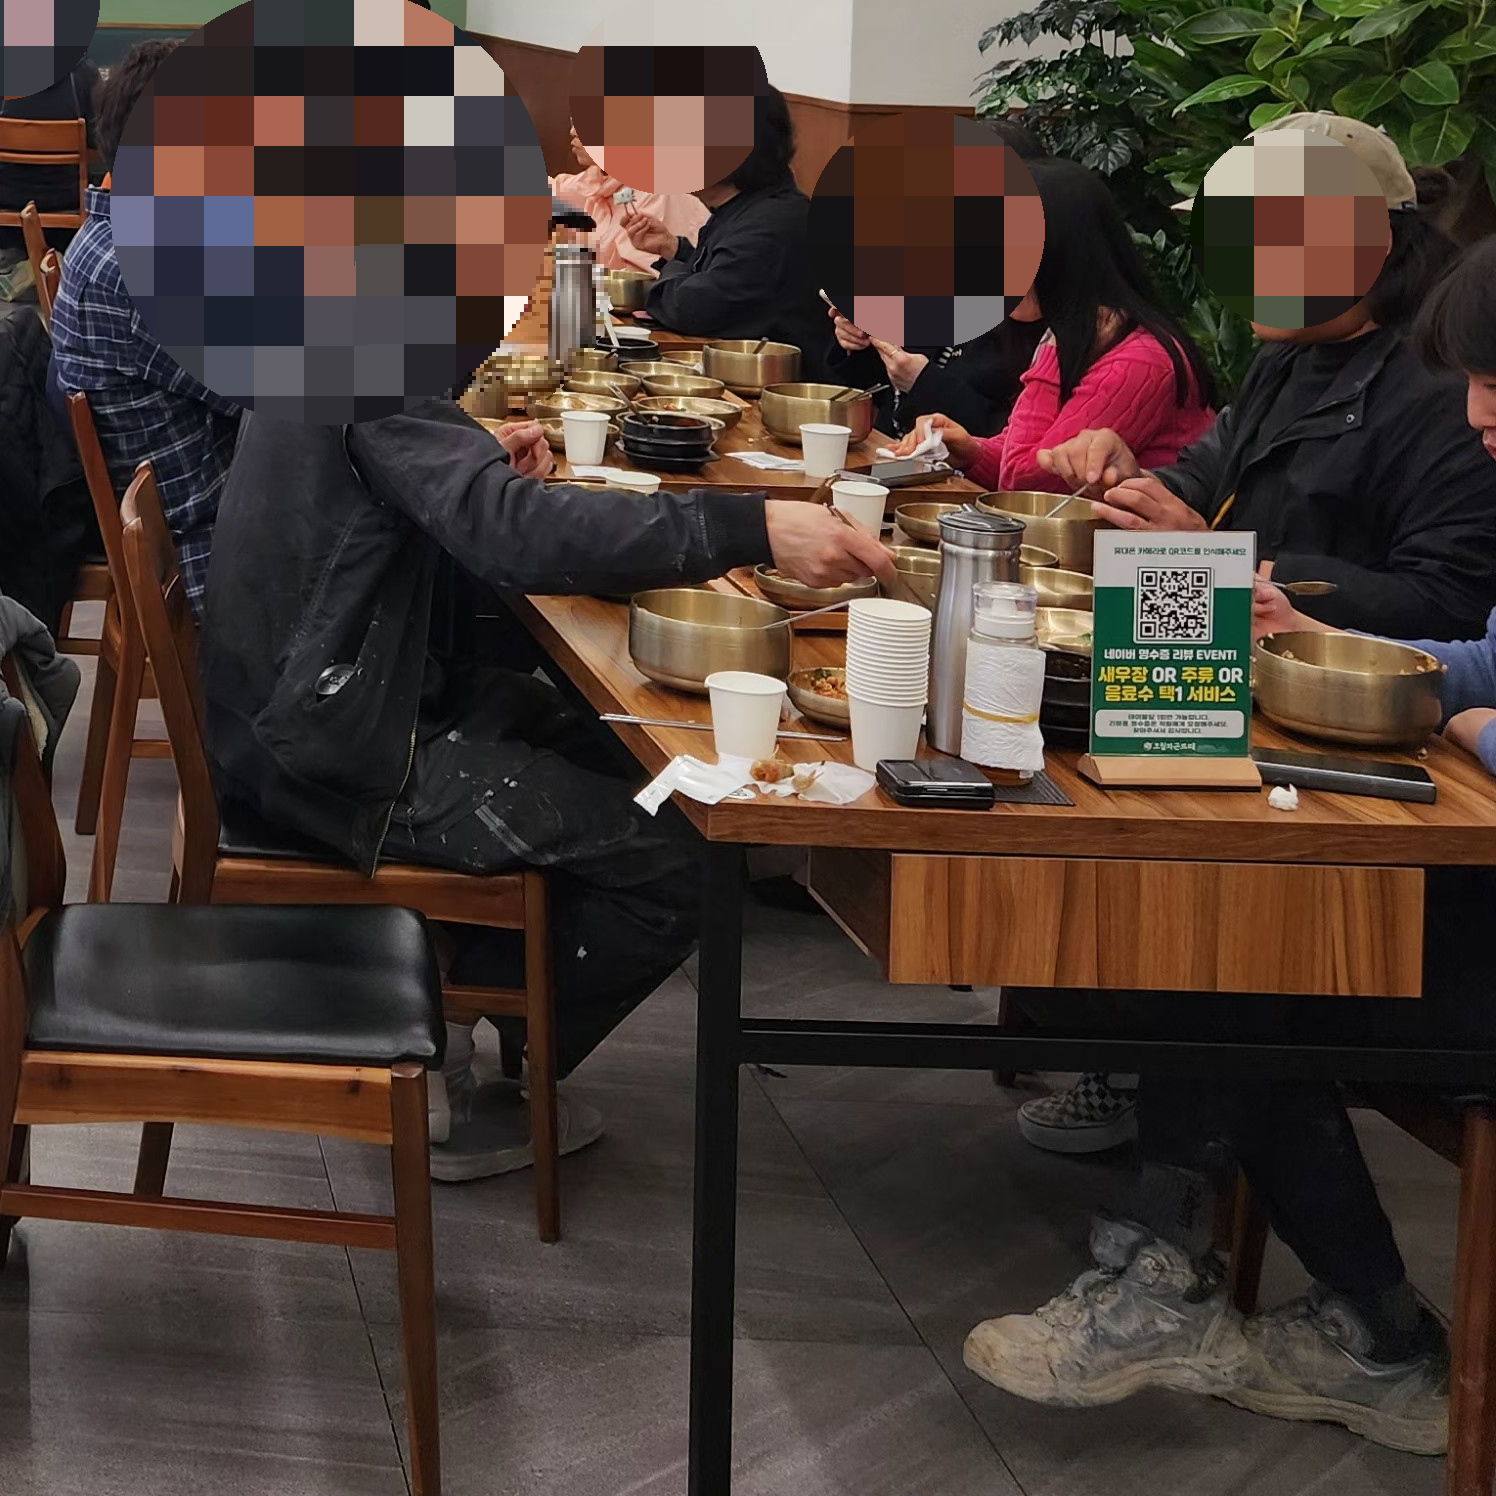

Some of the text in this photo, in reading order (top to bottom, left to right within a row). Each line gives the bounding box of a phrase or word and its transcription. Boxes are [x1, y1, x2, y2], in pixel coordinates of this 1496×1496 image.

[1114, 547, 1246, 556] 휴대폰 카메라로 QR코드를 인식해주세요
[1104, 648, 1237, 661] 네이버 영수증 리뷰 EVENT!
[1098, 666, 1244, 683] 새우장 OR 주류 OR
[1105, 685, 1236, 702] 음료수 택1 서비스
